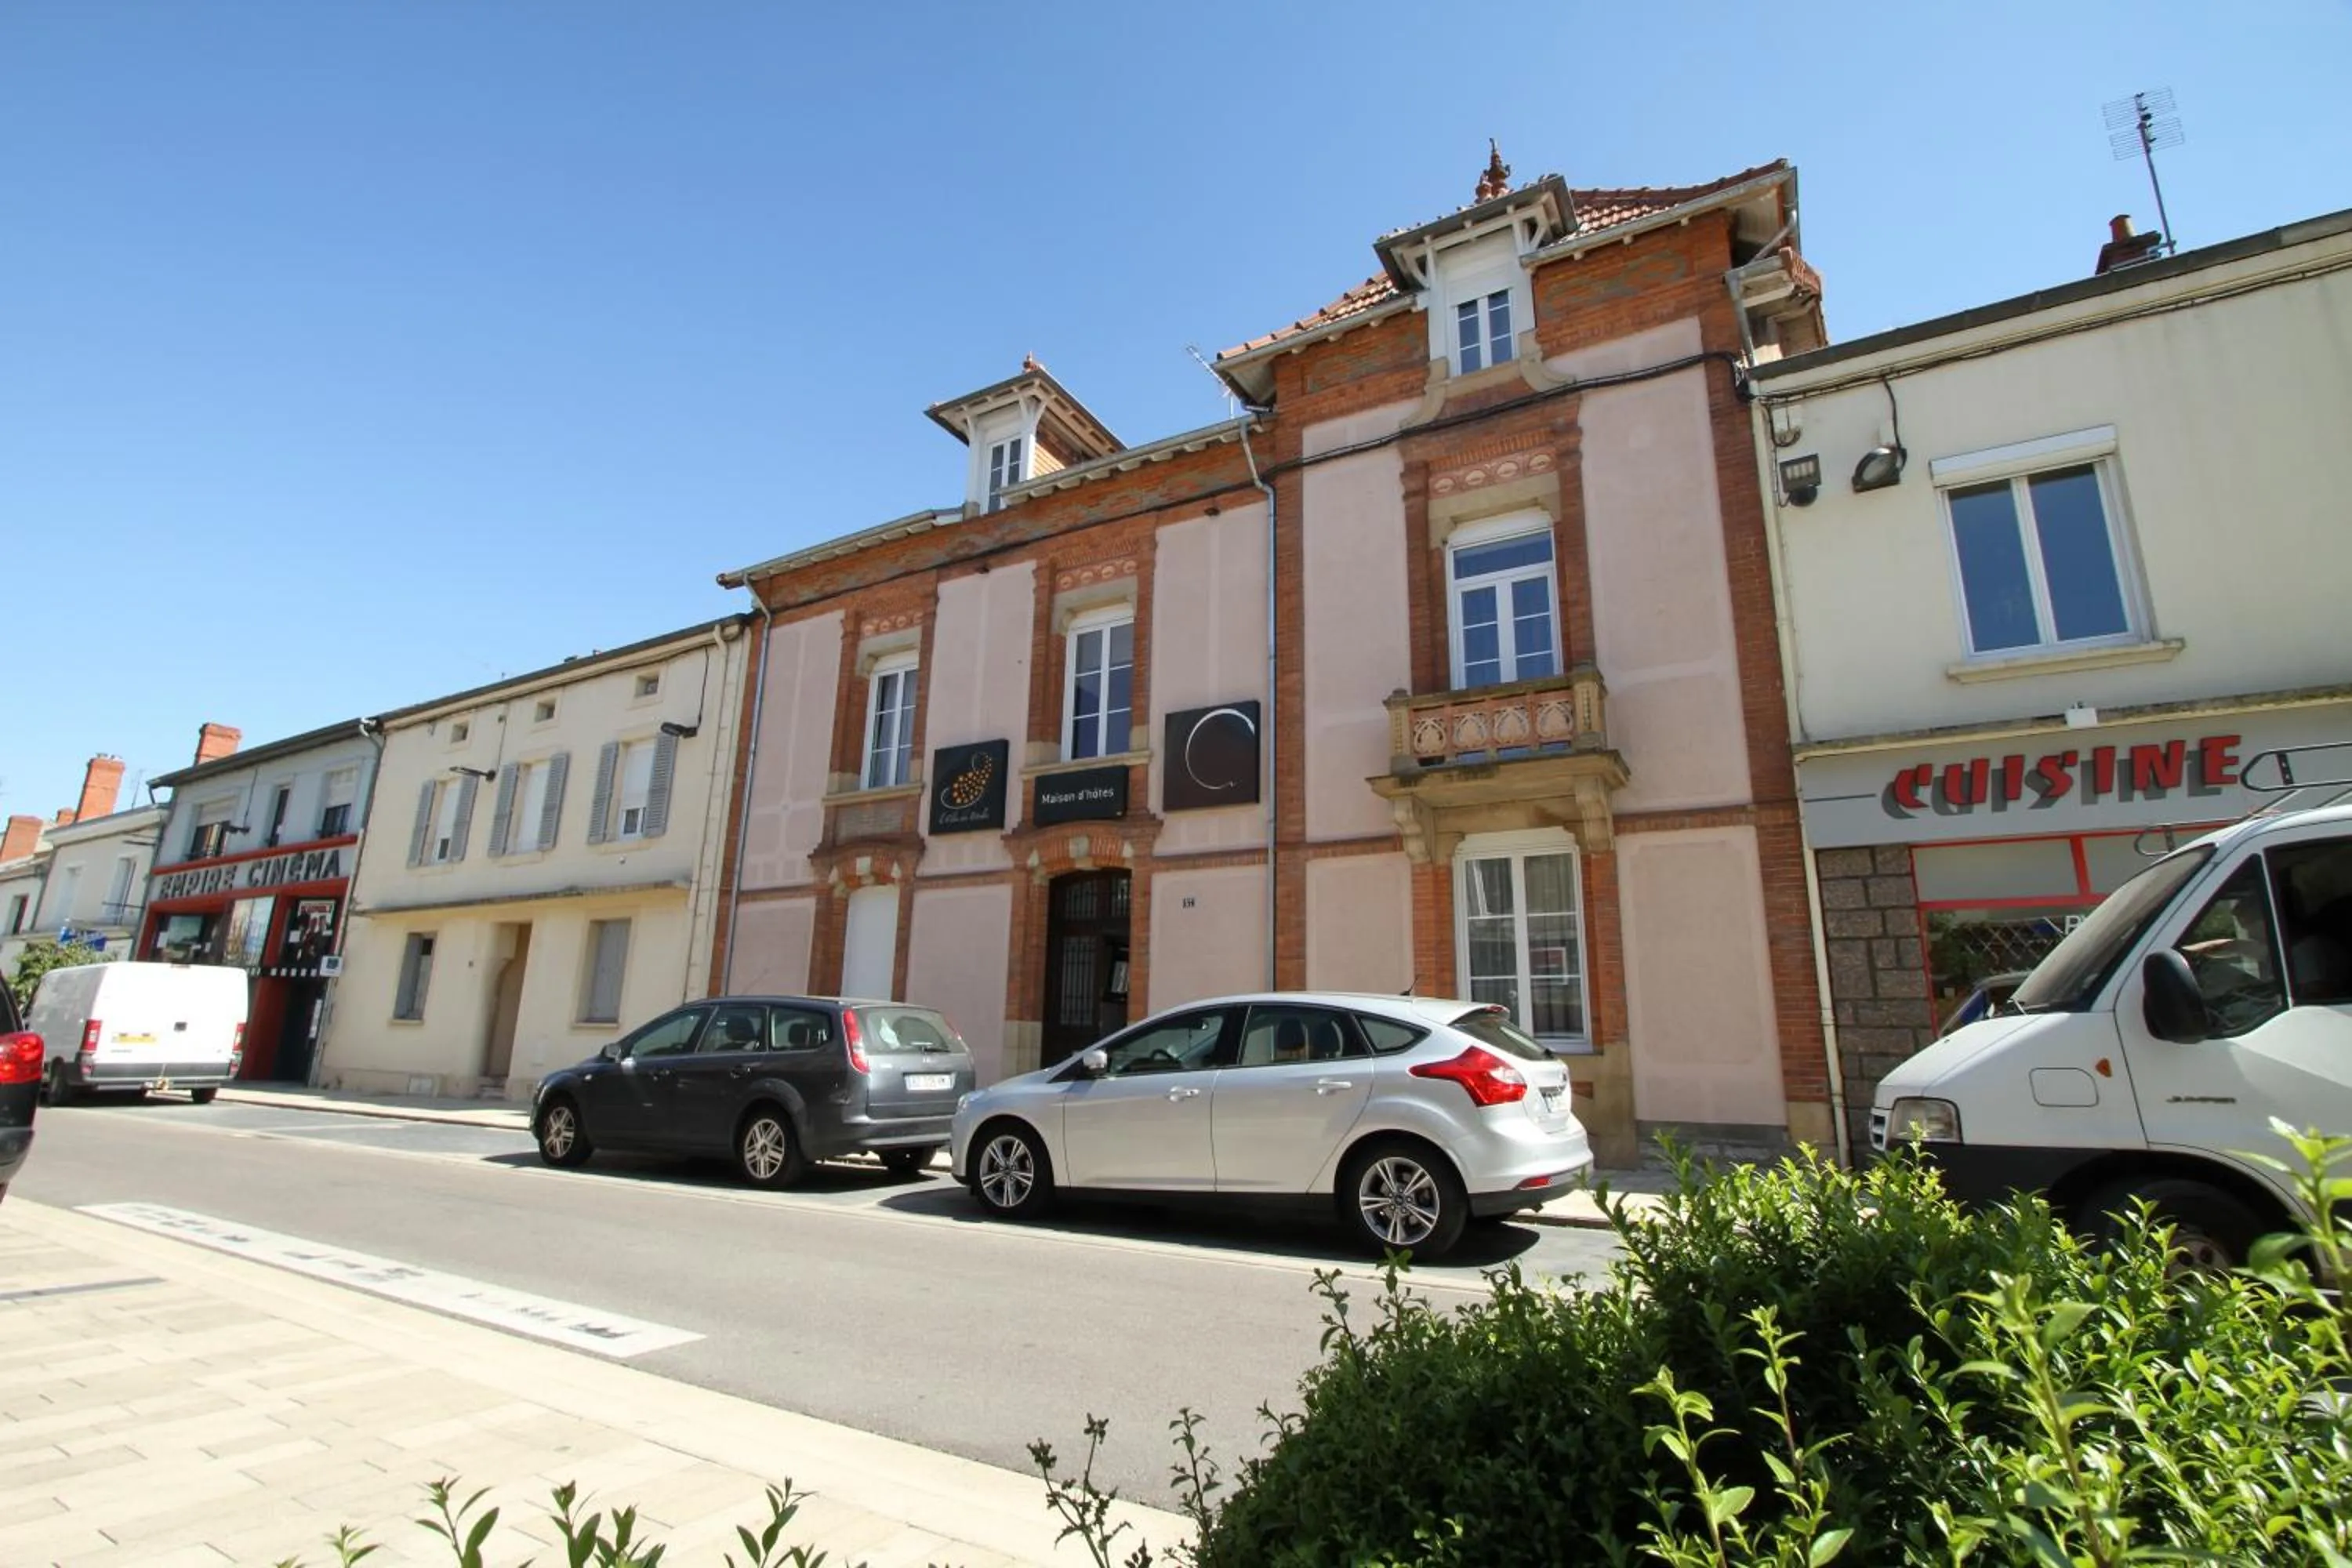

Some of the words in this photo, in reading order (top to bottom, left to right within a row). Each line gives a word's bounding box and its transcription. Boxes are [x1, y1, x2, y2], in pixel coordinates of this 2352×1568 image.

[1893, 734, 2241, 809] CUISINE
[1041, 793, 1075, 804] Maison
[158, 865, 238, 899] EMPIRE
